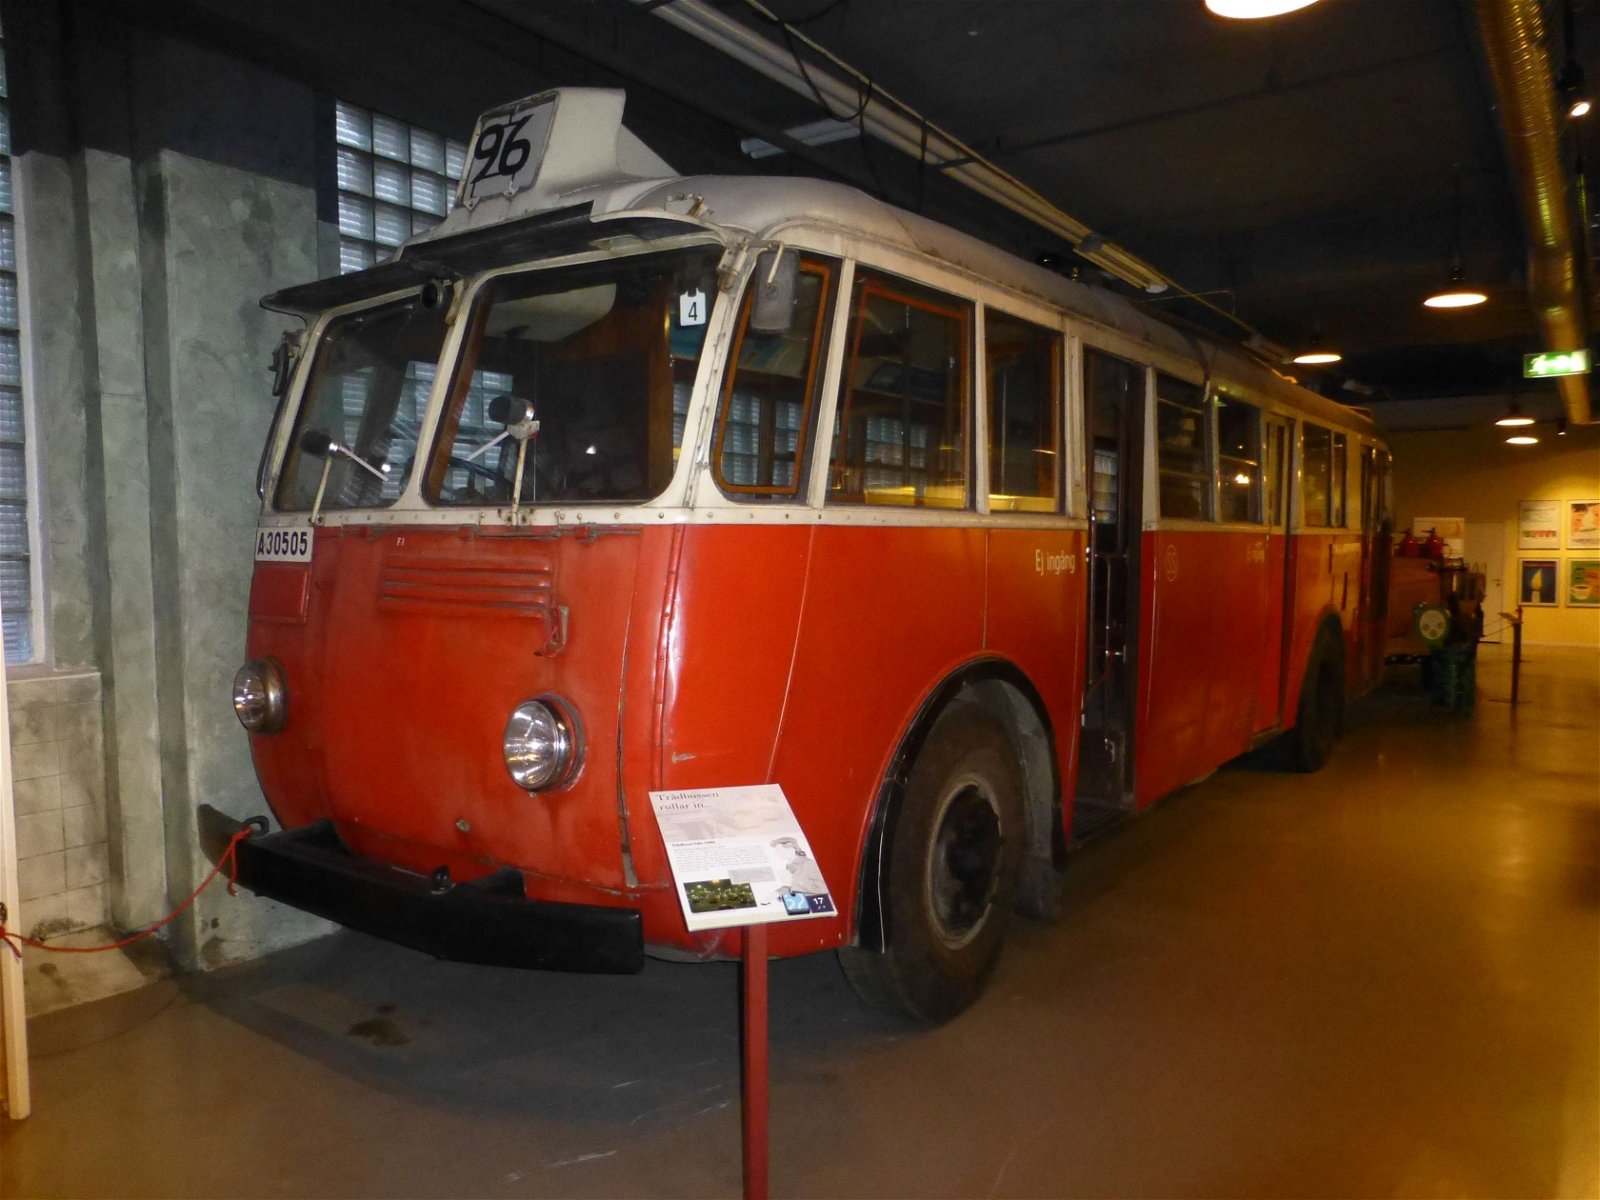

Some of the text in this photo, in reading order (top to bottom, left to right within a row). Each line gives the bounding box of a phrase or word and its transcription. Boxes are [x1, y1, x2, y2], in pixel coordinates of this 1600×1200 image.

[472, 114, 533, 183] 96
[688, 301, 698, 321] 4
[257, 531, 308, 556] A30505
[1035, 549, 1076, 576] Ej ingång
[655, 791, 719, 801] Trådbussen
[660, 802, 690, 811] rullar
[812, 897, 824, 905] 17
